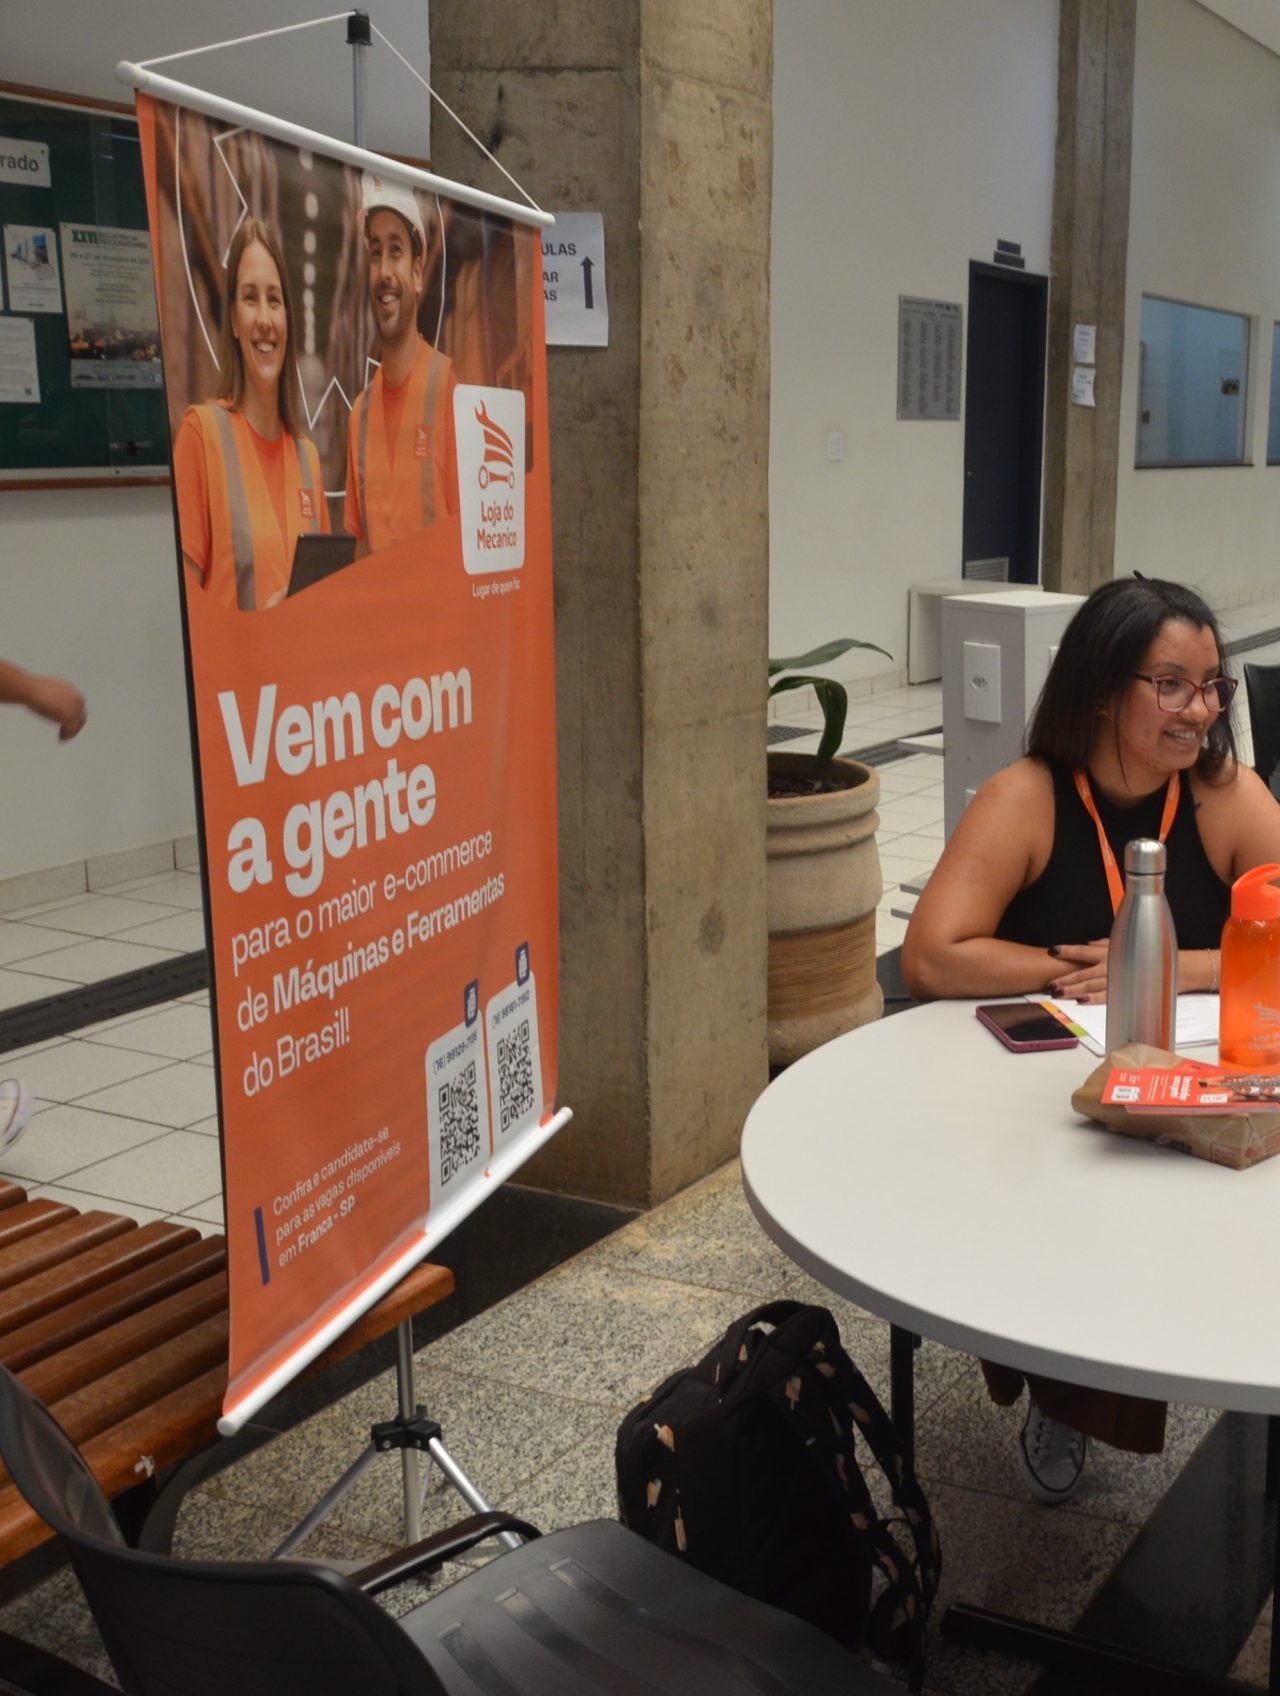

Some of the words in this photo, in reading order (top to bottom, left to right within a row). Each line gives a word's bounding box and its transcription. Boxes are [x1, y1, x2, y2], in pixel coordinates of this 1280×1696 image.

[481, 500, 501, 527] Loja
[504, 500, 514, 521] do
[217, 684, 364, 787] Vem
[371, 667, 472, 748] com
[227, 817, 273, 893] a
[283, 758, 436, 897] gente
[231, 916, 291, 976] para
[296, 909, 313, 939] o
[318, 878, 376, 931] maior
[383, 830, 492, 900] e-commerce
[237, 986, 268, 1032] de
[273, 941, 388, 1014] Máquinas
[392, 929, 404, 954] e
[407, 872, 505, 950] Ferramentas
[243, 1051, 273, 1097] do
[278, 1007, 350, 1078] Brasil!
[273, 1179, 313, 1215] Confira
[313, 1172, 320, 1186] e
[321, 1126, 389, 1180] candidate-se
[276, 1215, 301, 1246] para
[303, 1206, 315, 1222] as
[315, 1181, 345, 1211] vagas
[279, 1247, 297, 1267] em
[298, 1214, 333, 1252] Franca
[340, 1195, 356, 1217] SP
